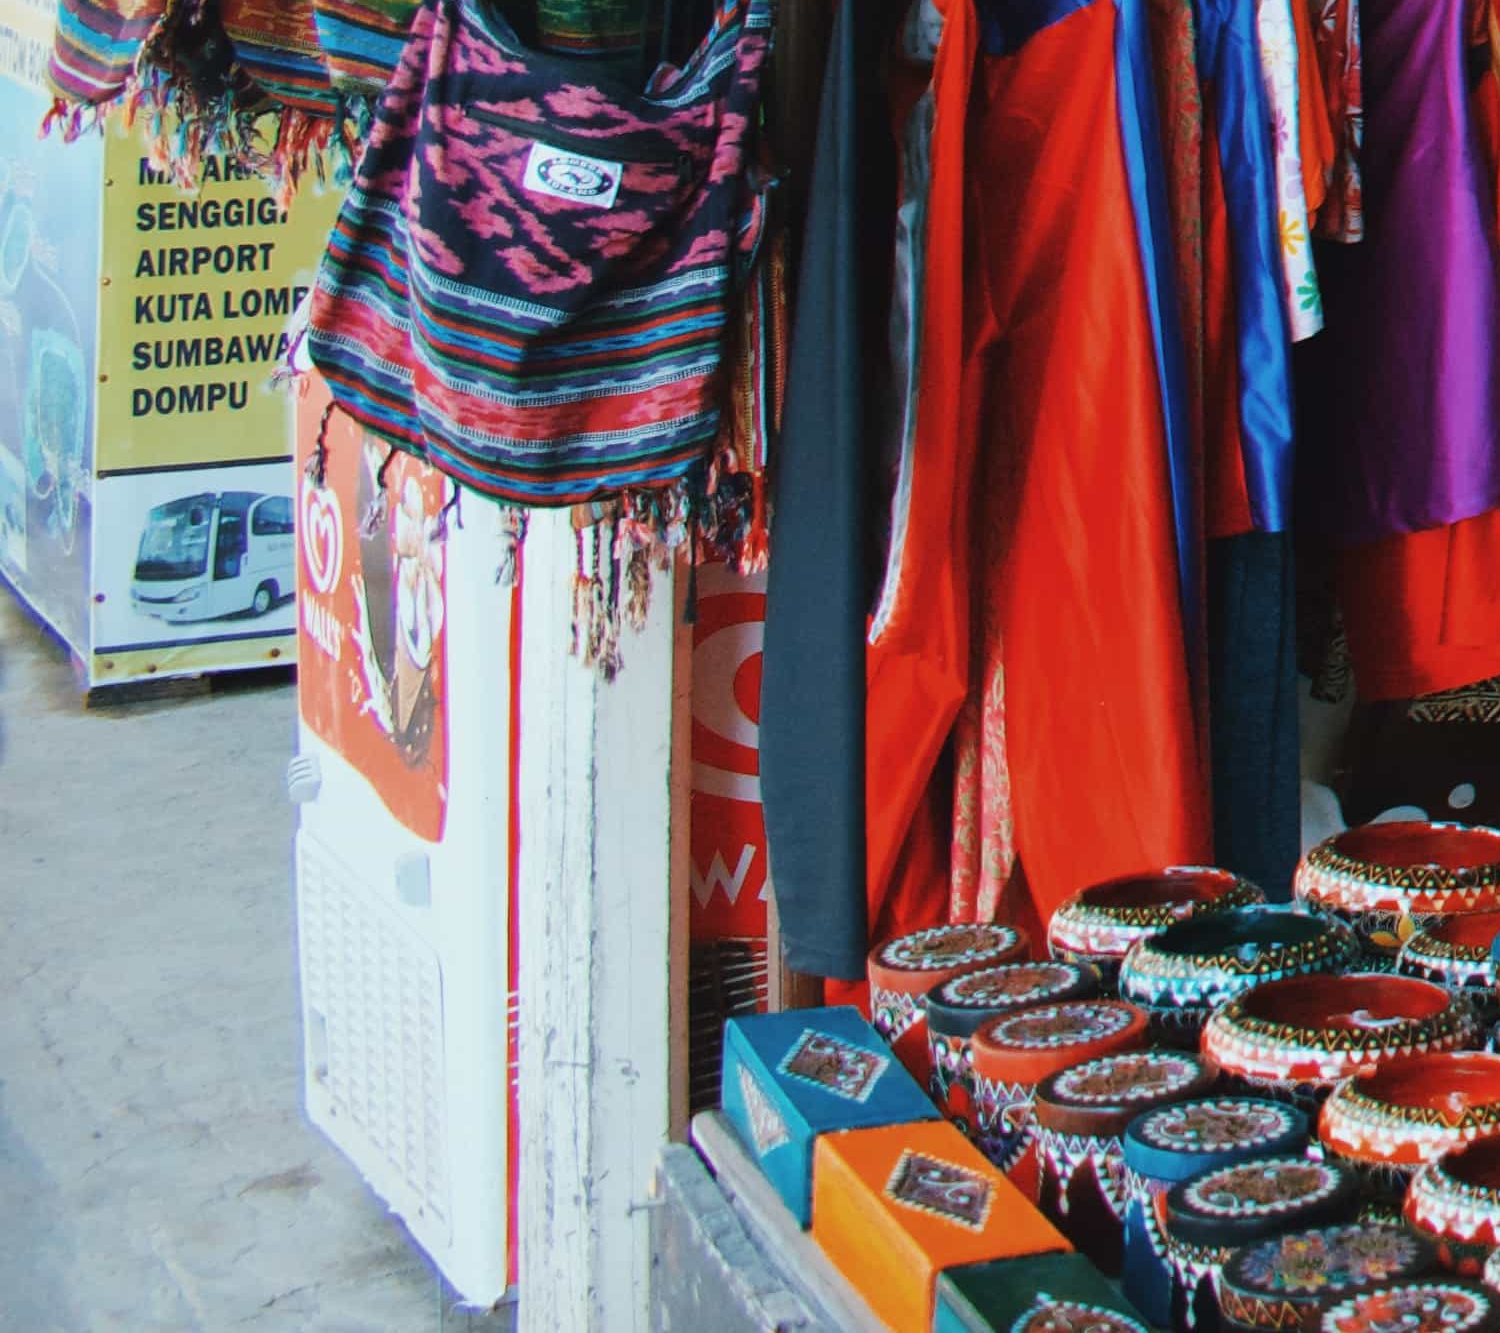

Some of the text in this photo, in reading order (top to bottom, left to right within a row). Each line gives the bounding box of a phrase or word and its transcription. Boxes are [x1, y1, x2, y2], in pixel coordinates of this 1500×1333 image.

[135, 243, 275, 277] AIRPORT
[135, 292, 213, 323] KUTA
[131, 332, 289, 371] SUMBAWA
[131, 381, 248, 416] DOMPU
[690, 842, 767, 910] W
